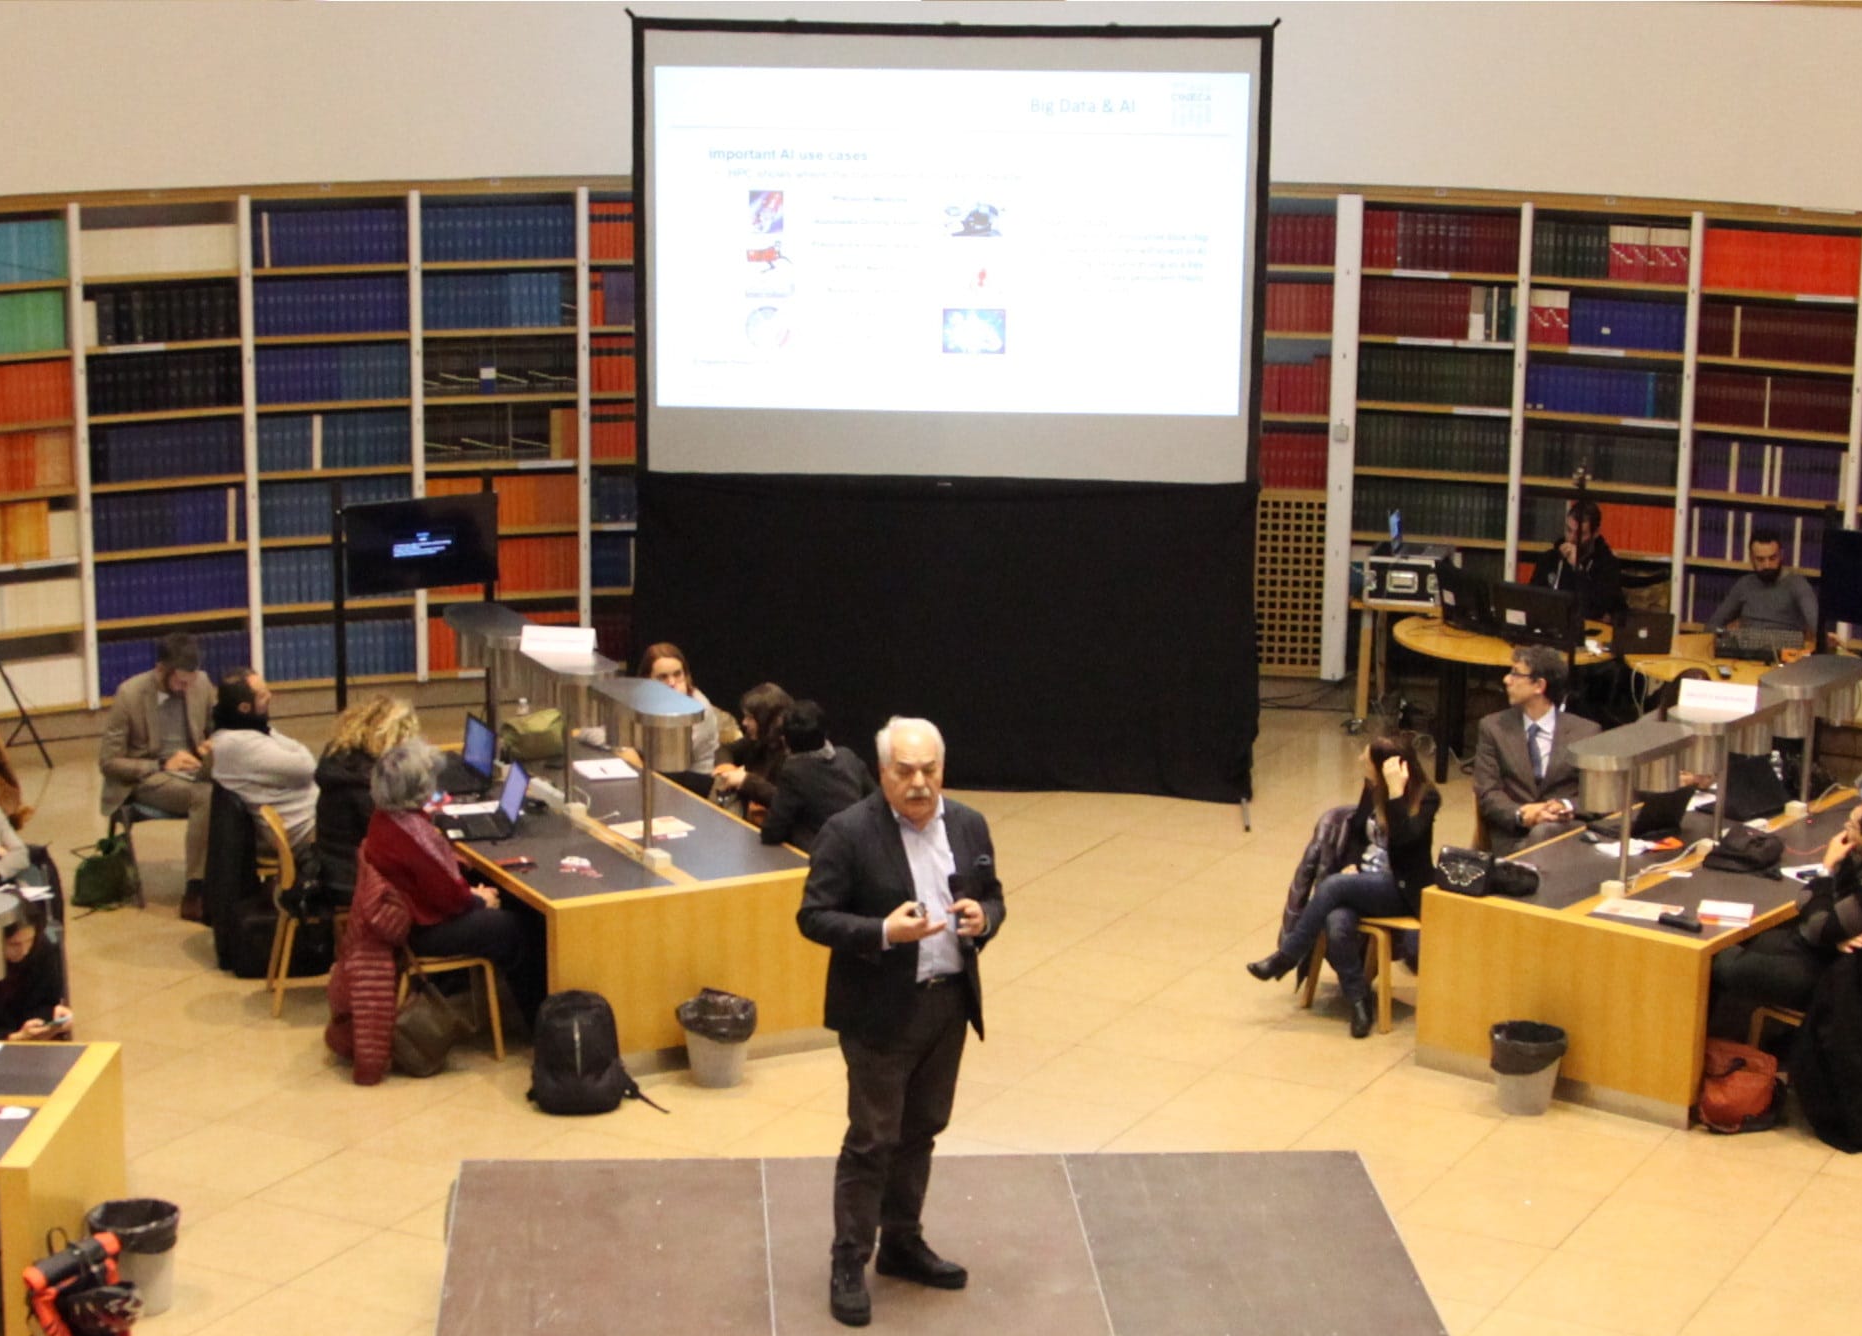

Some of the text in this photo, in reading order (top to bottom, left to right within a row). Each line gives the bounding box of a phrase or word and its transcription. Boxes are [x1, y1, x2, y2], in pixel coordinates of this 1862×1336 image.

[1030, 96, 1054, 116] Big
[1059, 97, 1097, 113] Data
[1101, 97, 1114, 114] &
[799, 151, 824, 161] use
[828, 151, 869, 162] cases
